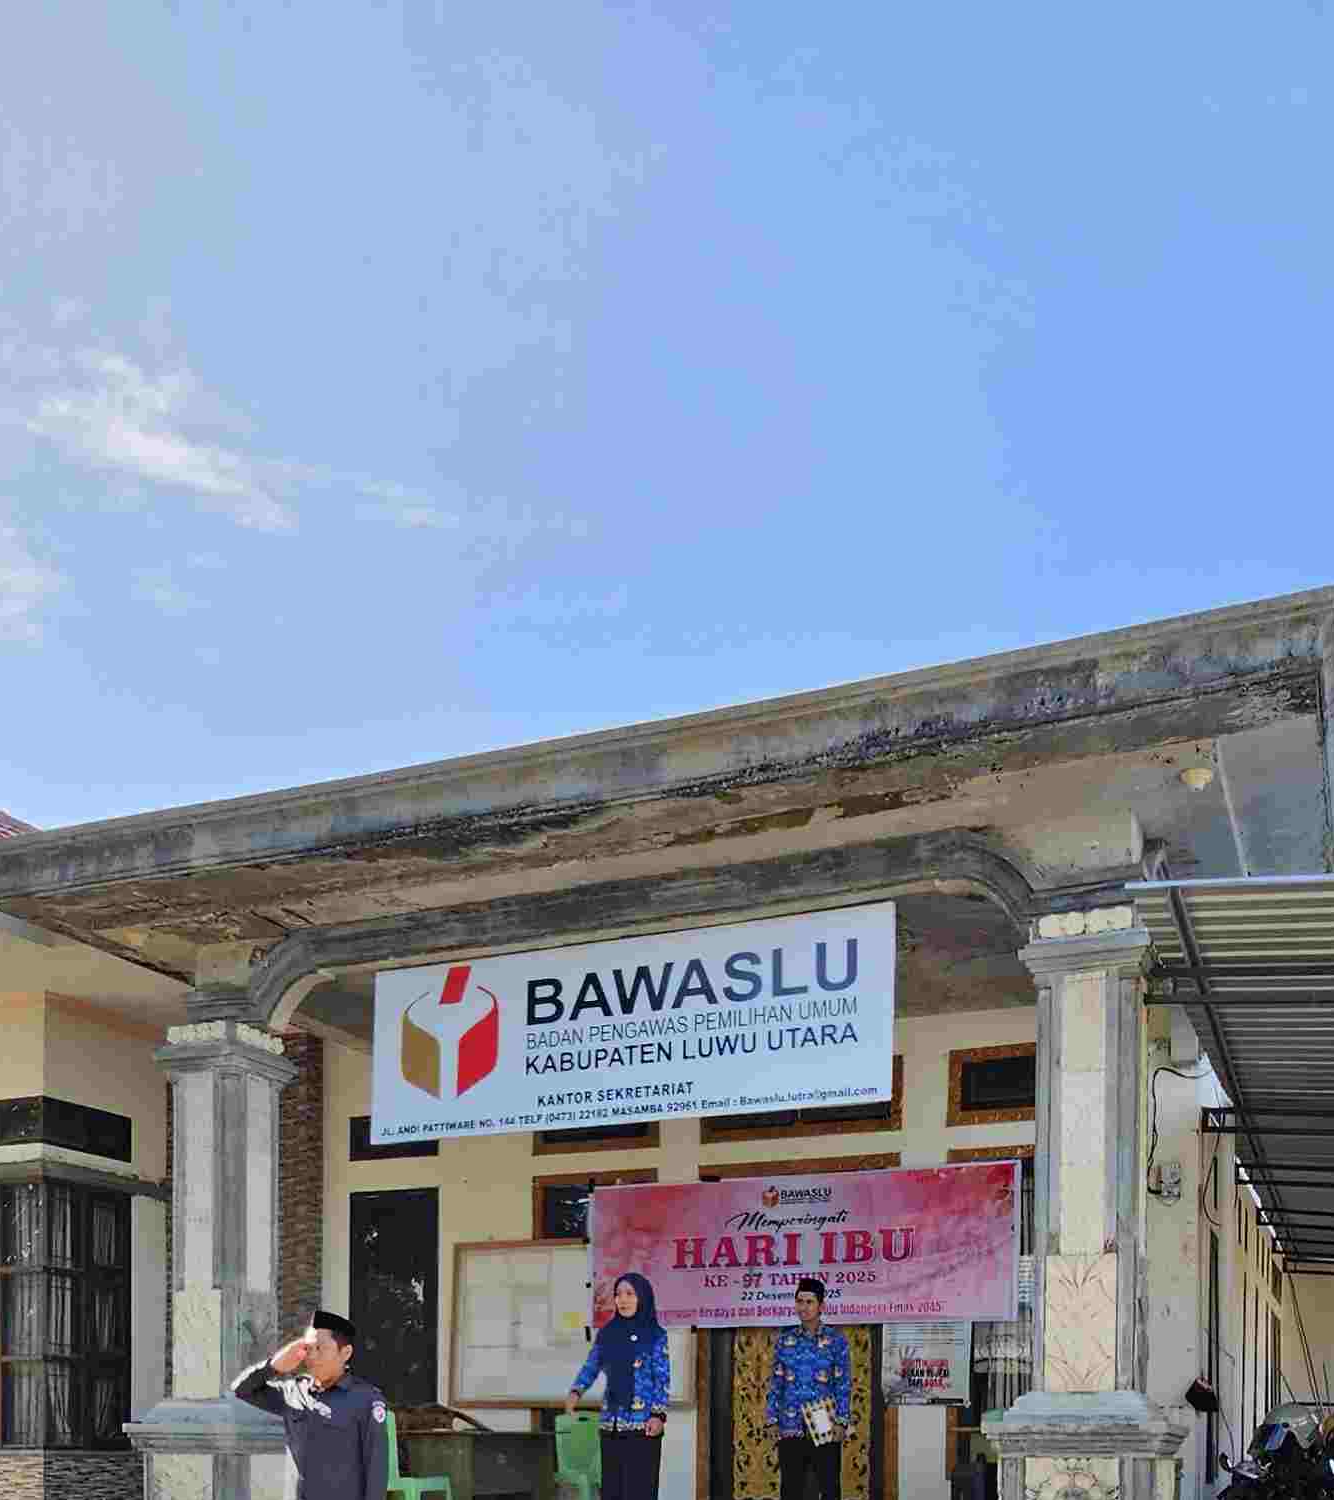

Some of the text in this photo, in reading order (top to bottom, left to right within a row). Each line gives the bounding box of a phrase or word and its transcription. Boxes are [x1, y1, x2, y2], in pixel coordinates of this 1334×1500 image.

[526, 938, 858, 1025] BAWASLU
[527, 996, 858, 1050] BADAN PENGAWAS PEMILIHAN UMUM
[526, 1022, 858, 1075] KABUPATEN LUWU UTARA
[537, 1081, 694, 1107] KANTOR SEKRETARIAT
[701, 1097, 730, 1110] Email
[780, 1186, 832, 1200] BAWASLU
[724, 1209, 850, 1232] Memperingati
[672, 1226, 915, 1269] HARI IBU
[703, 1274, 728, 1288] KE
[835, 1271, 876, 1287] 2025
